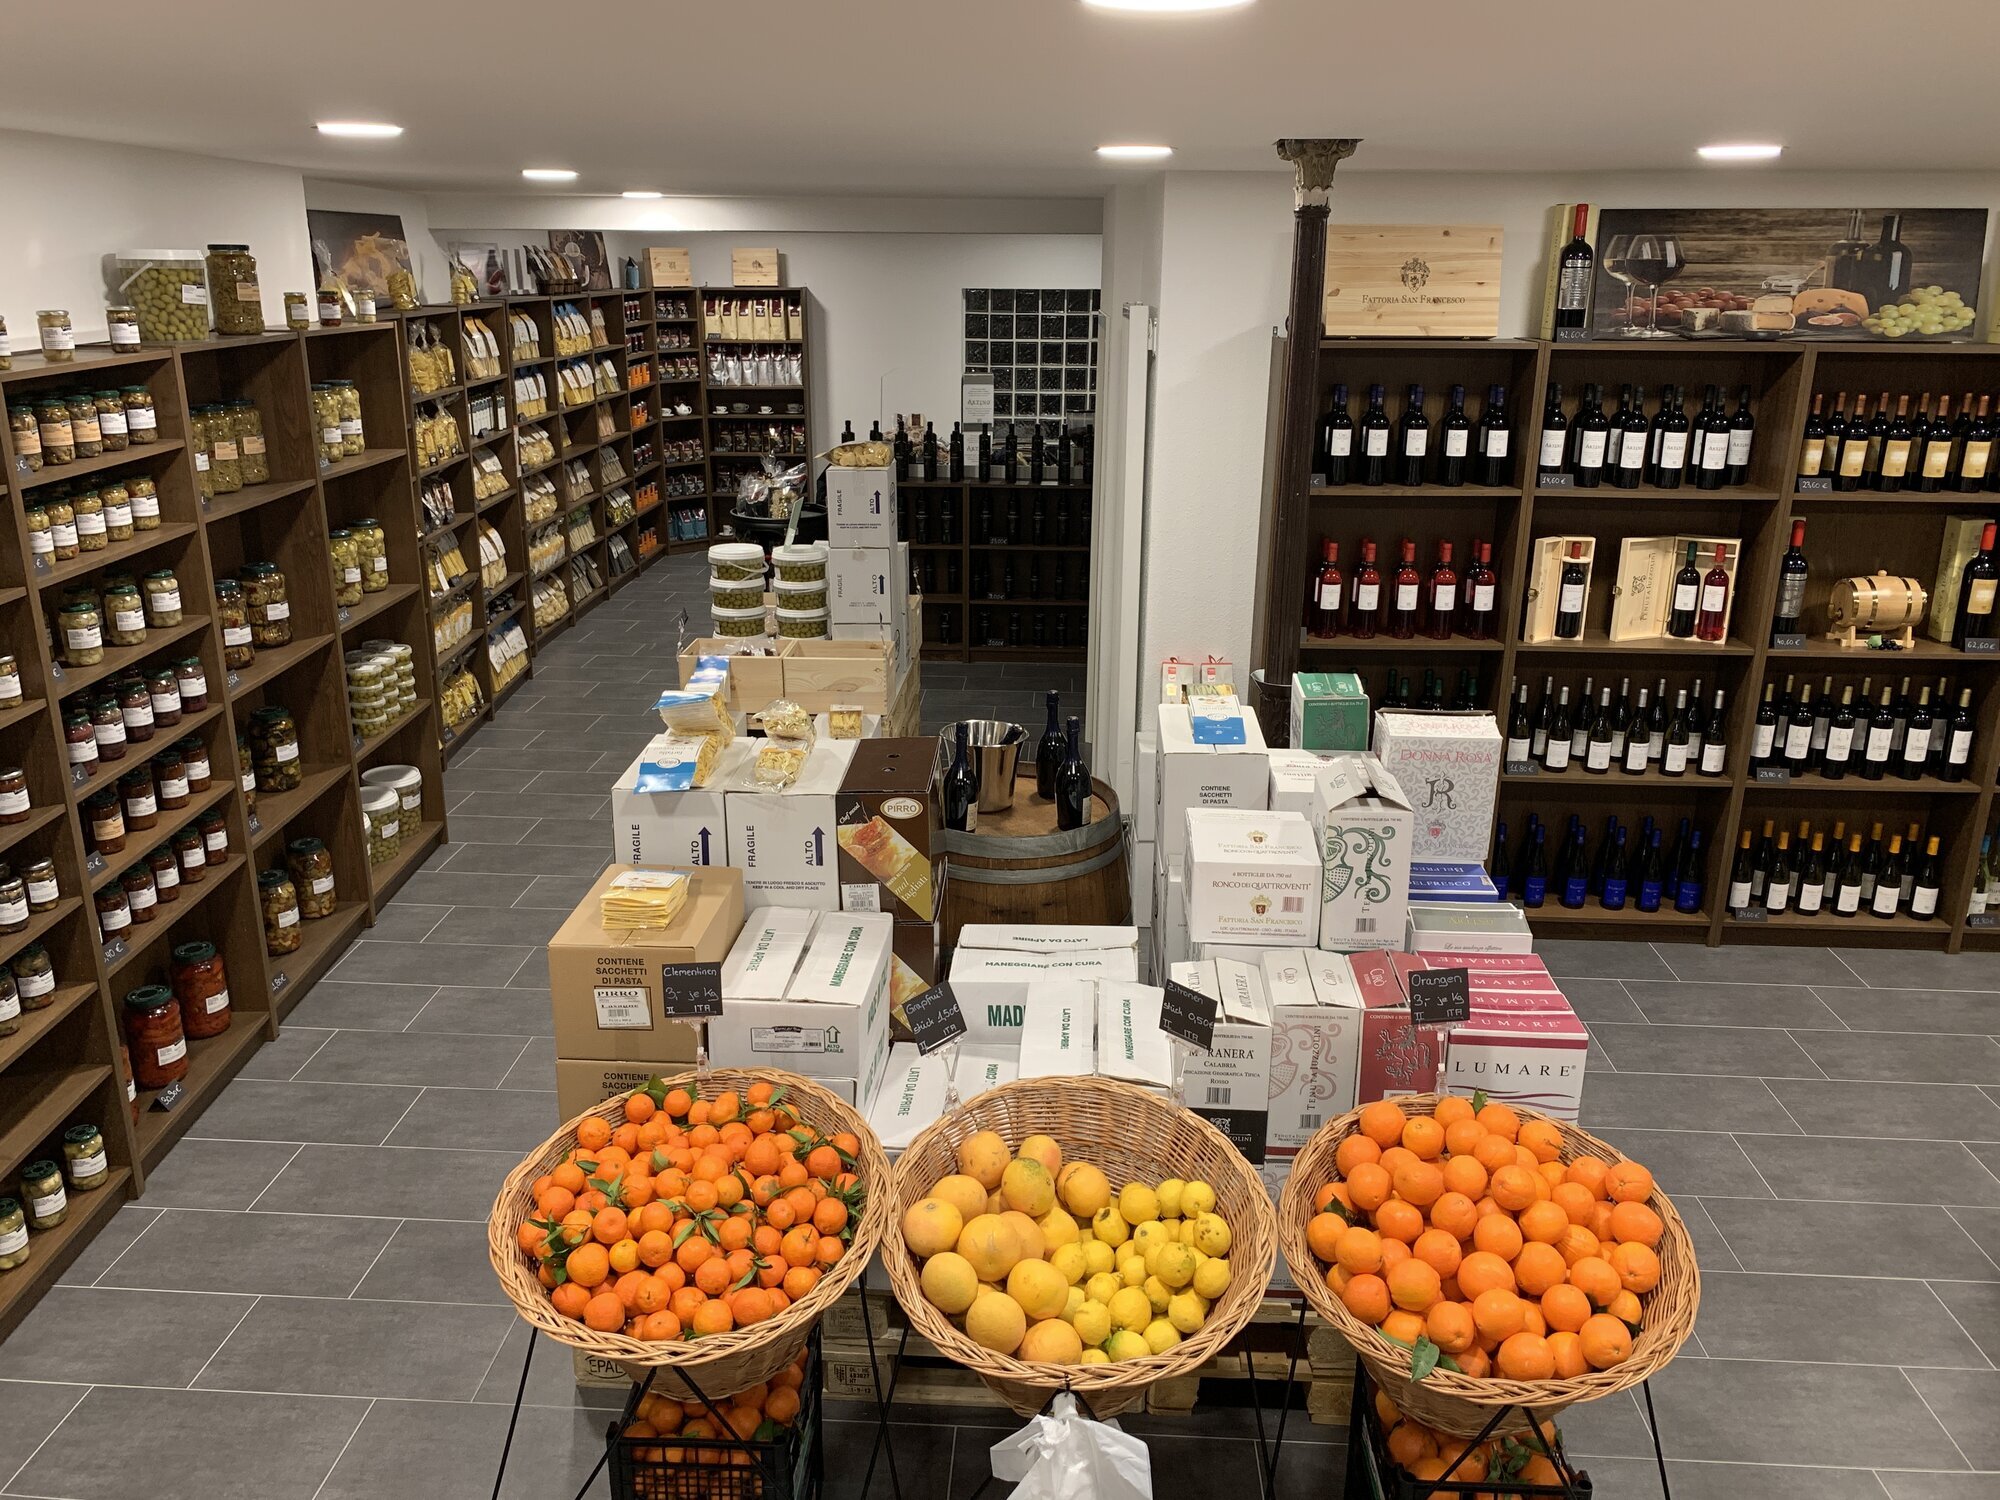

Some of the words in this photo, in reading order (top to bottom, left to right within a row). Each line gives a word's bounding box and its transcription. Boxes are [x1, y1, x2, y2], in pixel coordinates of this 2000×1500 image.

[1362, 294, 1399, 304] FATTORIA
[1401, 294, 1418, 304] SAN
[1420, 294, 1465, 304] FRANCESCO
[1400, 749, 1450, 762] DONNA
[1455, 751, 1492, 763] ROSA
[887, 804, 917, 813] PIRRO
[632, 824, 641, 865] FRAGILE
[746, 825, 756, 868] FRAGILE
[691, 840, 700, 865] ALTO
[805, 840, 814, 866] ALTO
[1212, 880, 1240, 889] RONCO
[1251, 881, 1309, 891] QUATTROVENTI
[1218, 916, 1248, 924] FATTORIA
[1250, 916, 1264, 924] SAN
[761, 928, 776, 942] LATO
[597, 957, 645, 966] CONTIENE
[829, 952, 853, 987] MANEGGIARE
[848, 926, 864, 941] CURA
[595, 967, 647, 976] SACCHETTI
[663, 967, 717, 977] Clementinen
[602, 977, 611, 985] DI
[614, 977, 643, 985] PASTA
[1411, 974, 1463, 988] Orangen
[688, 990, 700, 1001] je
[1437, 996, 1447, 1006] je
[1474, 996, 1549, 1005] LUMAR
[694, 1004, 711, 1013] ITA
[1122, 999, 1131, 1015] CURA
[1446, 1008, 1463, 1018] ITA
[987, 1005, 1026, 1027] MAD
[1063, 1008, 1071, 1023] LATO
[1122, 1015, 1132, 1027] CON
[1189, 1048, 1254, 1060] MRANERA
[1203, 1060, 1237, 1068] CALABRIA
[1455, 1061, 1572, 1077] LUMARE
[603, 1072, 650, 1081] CONTIENE
[908, 1066, 921, 1082] LATO
[589, 1360, 623, 1374] EPAL
